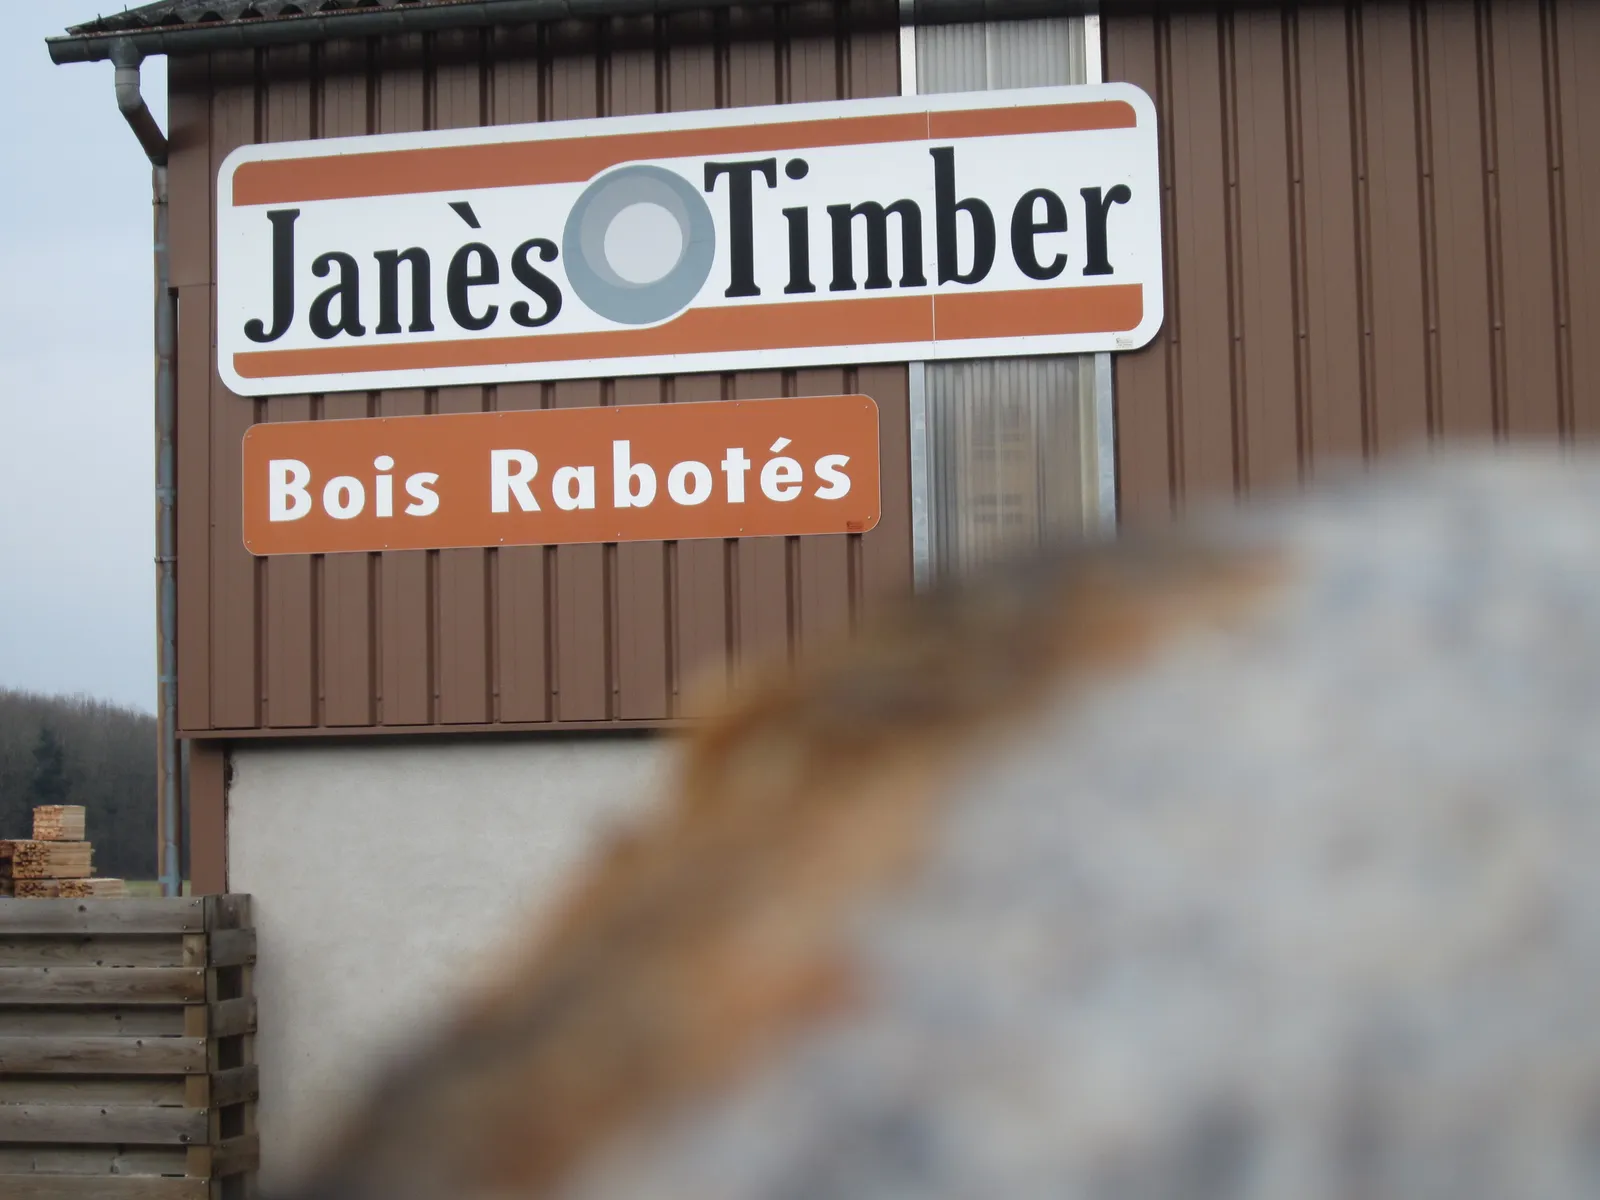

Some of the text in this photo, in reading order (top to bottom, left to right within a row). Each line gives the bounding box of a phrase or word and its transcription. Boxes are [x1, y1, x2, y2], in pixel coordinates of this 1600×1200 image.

[245, 147, 1131, 342] Janès Timber
[269, 437, 850, 521] Bois Rabotés
